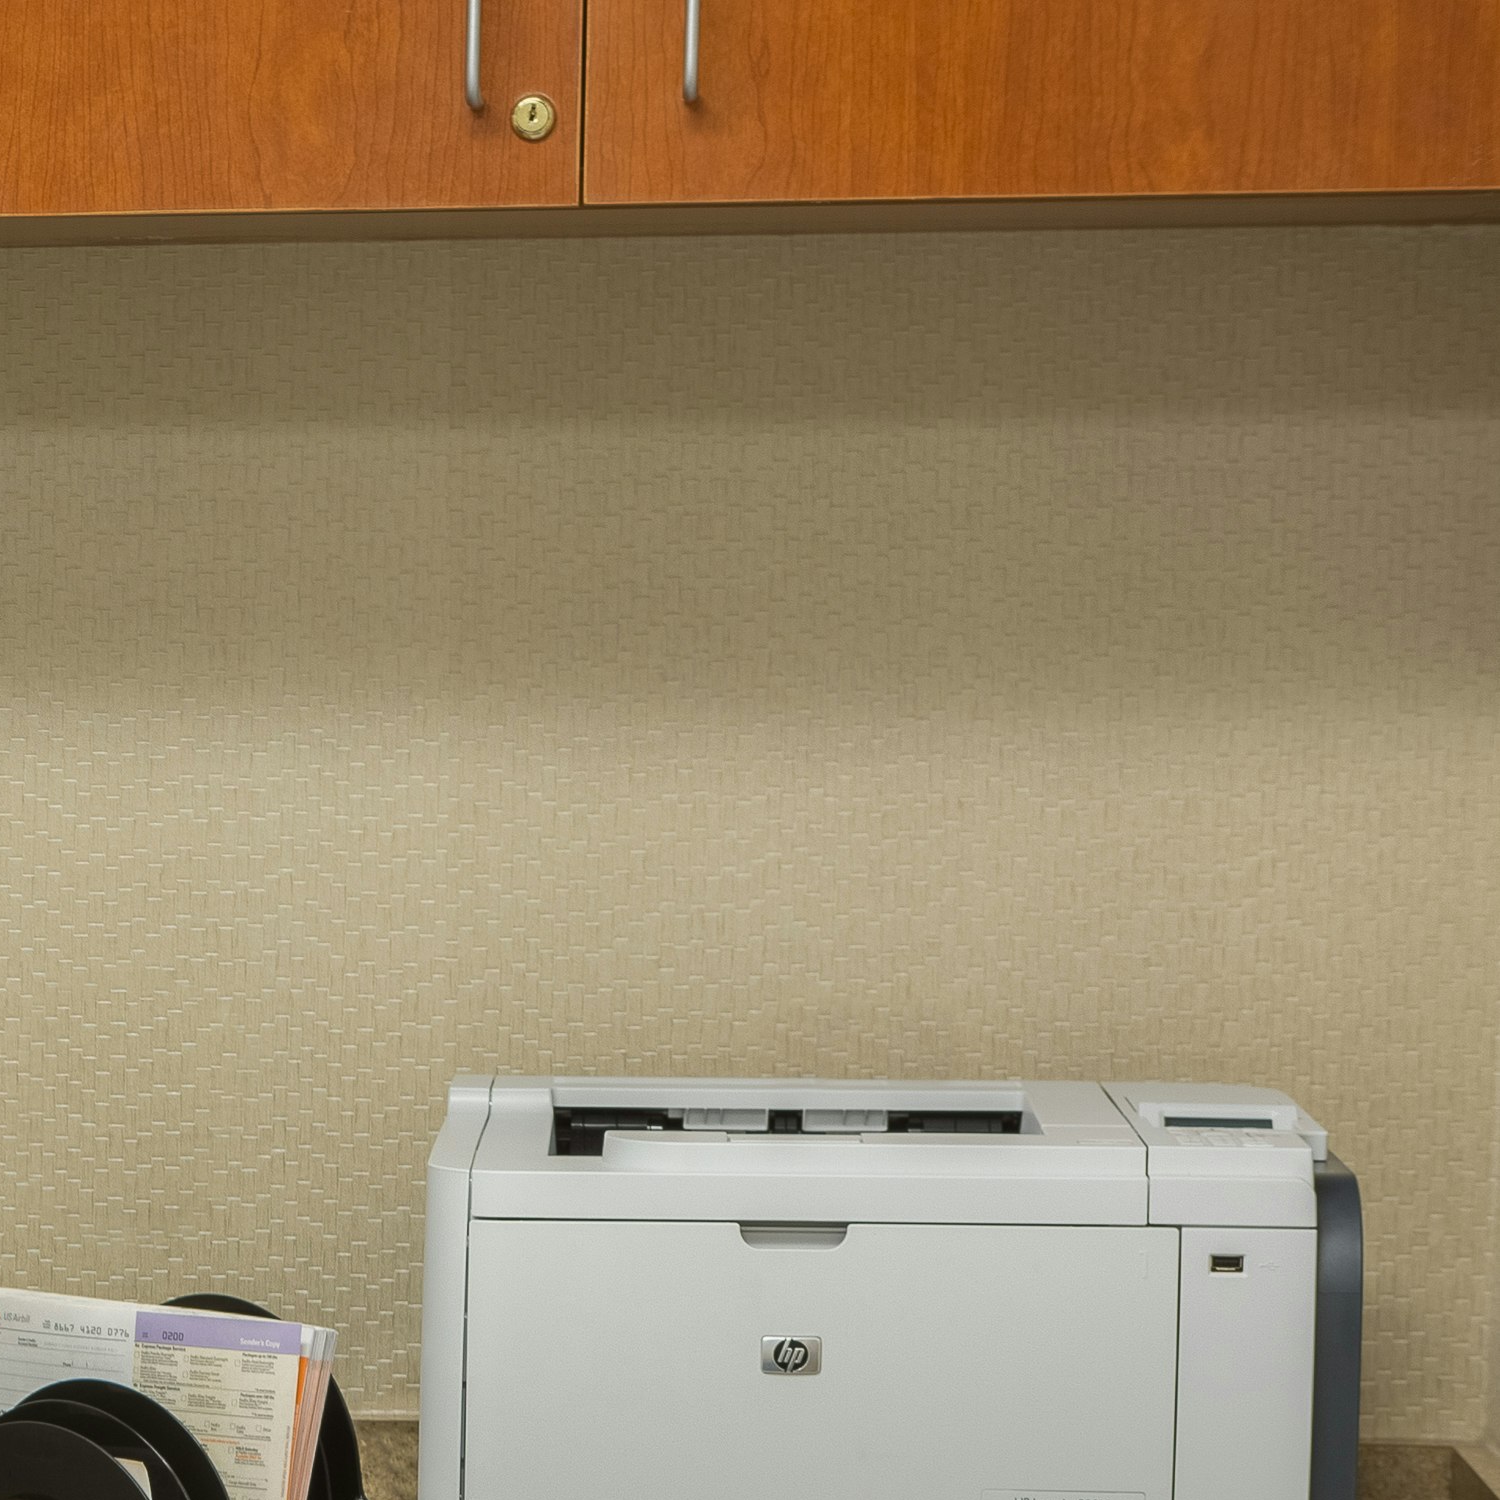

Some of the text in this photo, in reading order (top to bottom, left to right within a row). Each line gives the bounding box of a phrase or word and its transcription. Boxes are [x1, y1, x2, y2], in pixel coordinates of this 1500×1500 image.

[53, 1322, 75, 1333] 8667
[80, 1325, 102, 1336] 4120
[107, 1327, 130, 1338] 0776
[161, 1330, 184, 1342] 0200
[239, 1336, 281, 1349] Sender's Copy
[777, 1337, 806, 1373] hp
